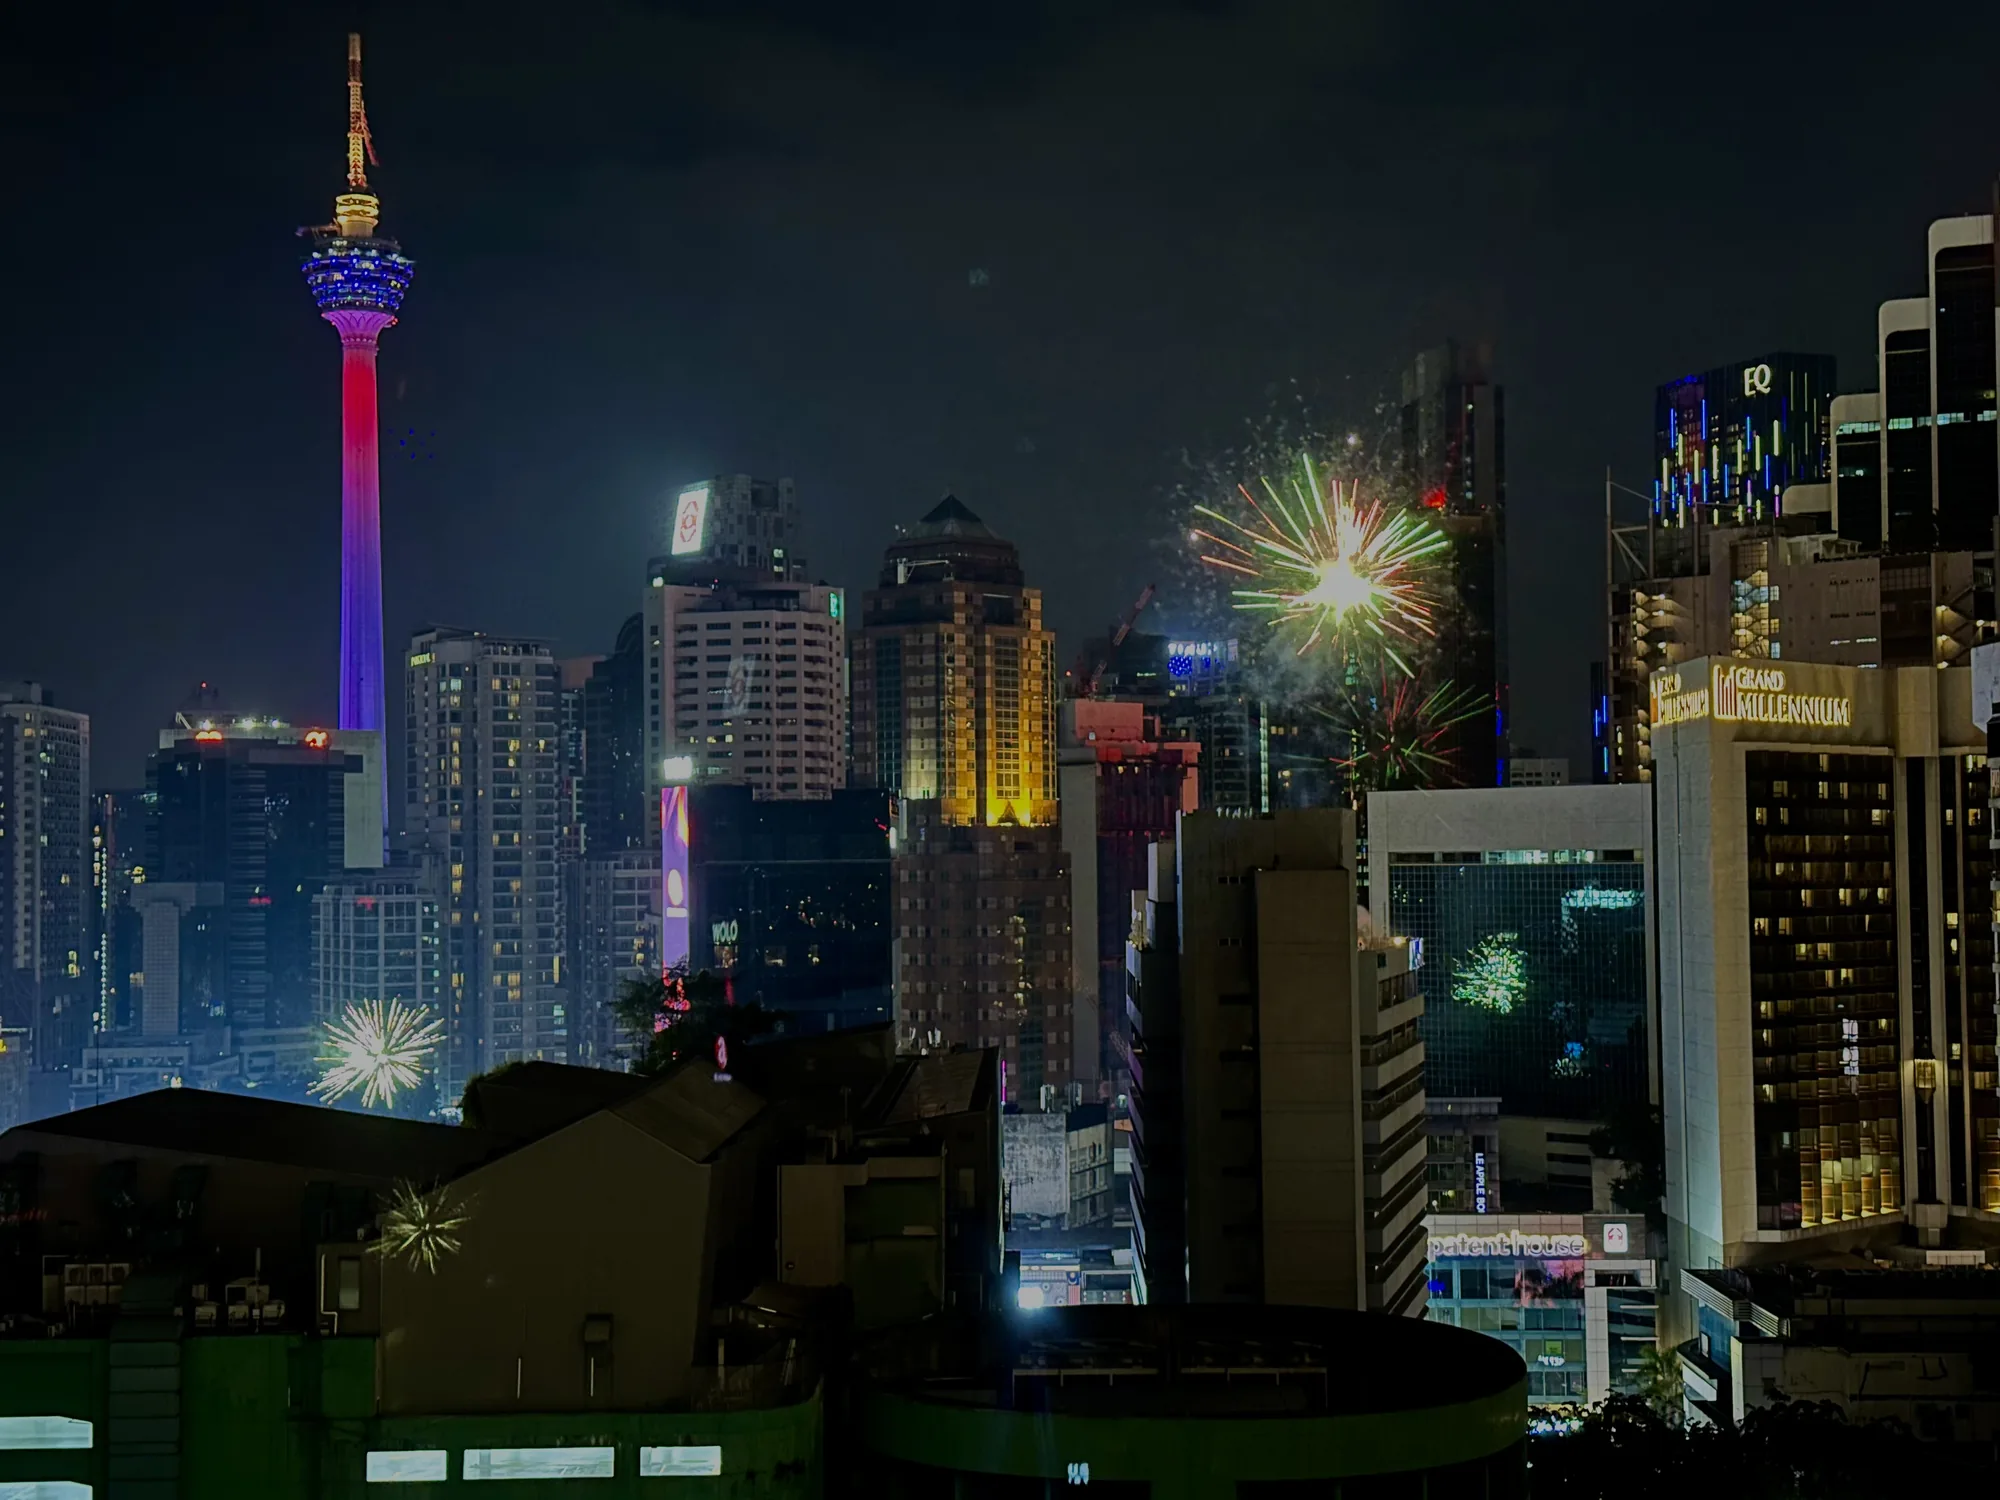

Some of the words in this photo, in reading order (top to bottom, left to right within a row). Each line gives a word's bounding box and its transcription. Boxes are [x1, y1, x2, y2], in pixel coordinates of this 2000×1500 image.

[1744, 364, 1770, 396] EQ
[1736, 667, 1785, 691] GRAND
[1737, 692, 1850, 726] MILLENNIUM
[1475, 1153, 1484, 1164] LE
[1476, 1165, 1485, 1195] APPLE
[1428, 1233, 1509, 1260] patent
[1510, 1229, 1586, 1257] house
